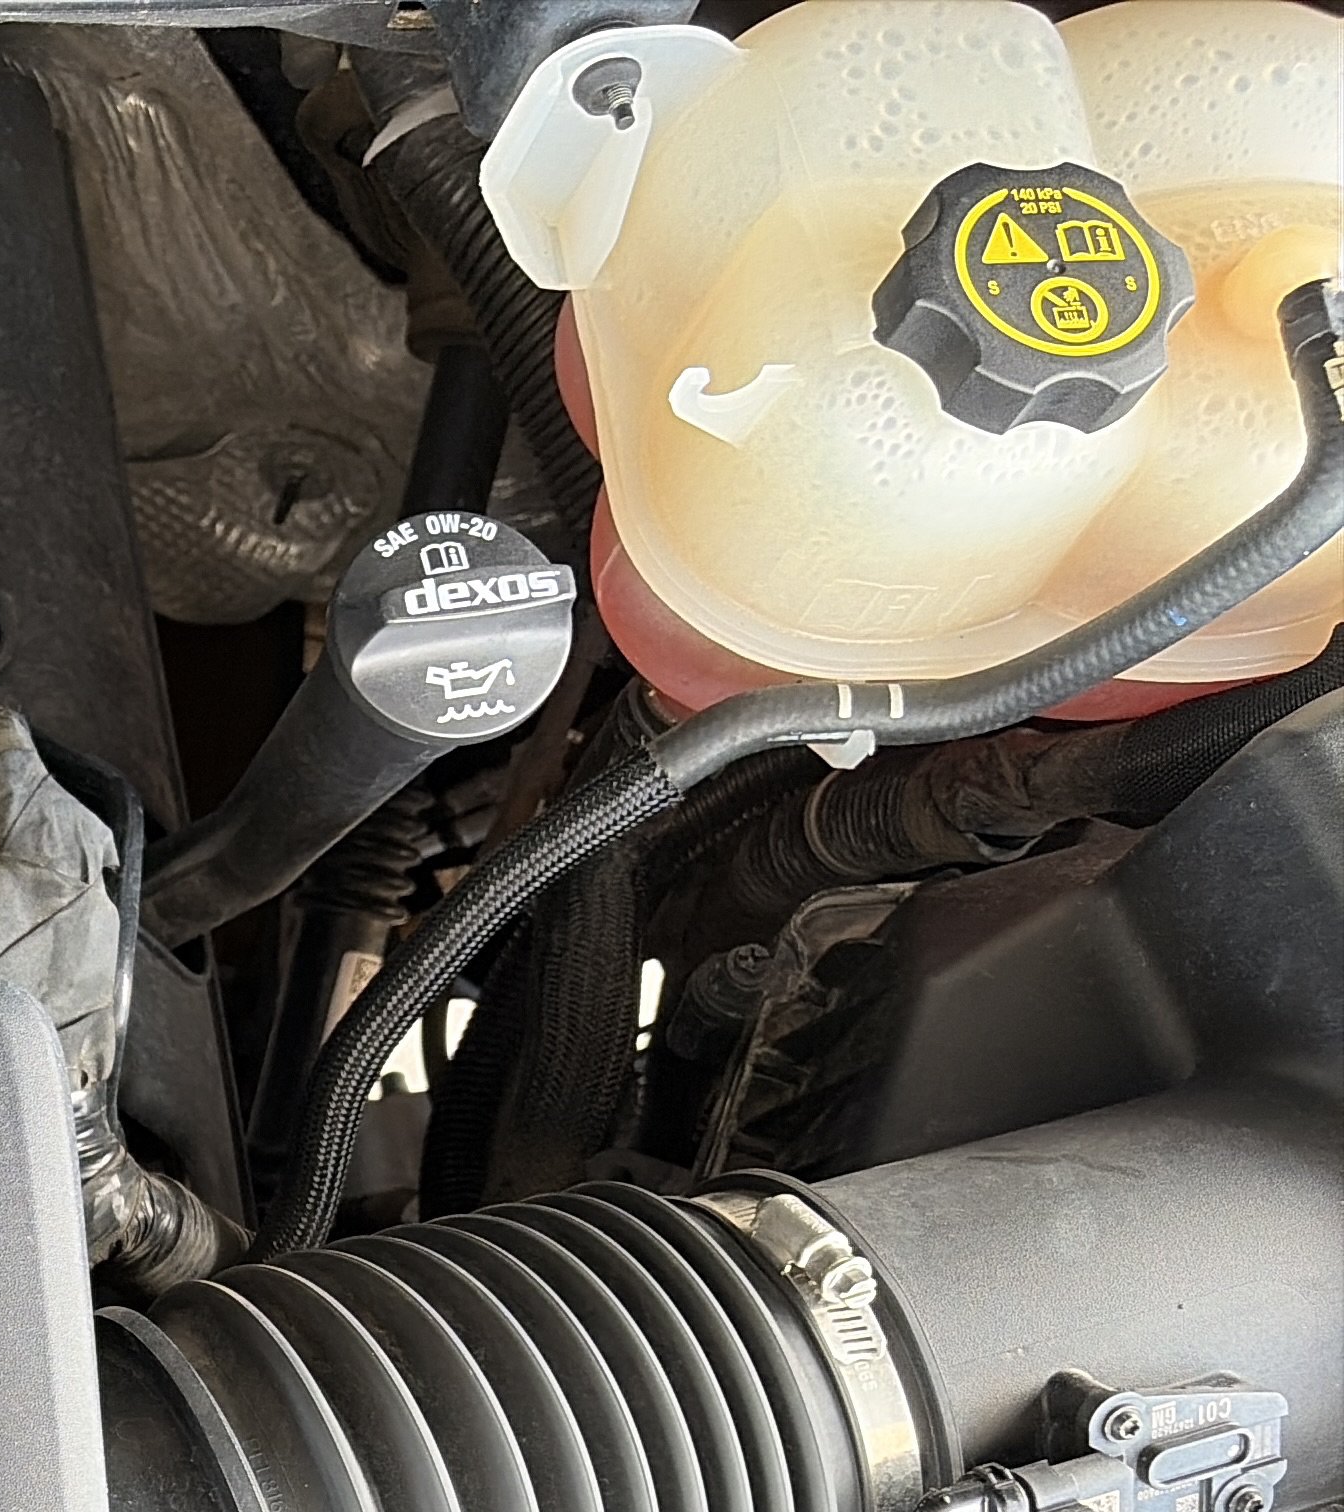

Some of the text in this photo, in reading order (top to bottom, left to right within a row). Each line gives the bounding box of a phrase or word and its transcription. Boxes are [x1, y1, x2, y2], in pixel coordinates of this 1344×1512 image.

[1010, 187, 1063, 201] 140 kPa
[1020, 201, 1063, 215] 20 PSI
[373, 513, 498, 558] SAE 0W-20
[1152, 1402, 1176, 1430] GM
[1198, 1397, 1232, 1425] C01
